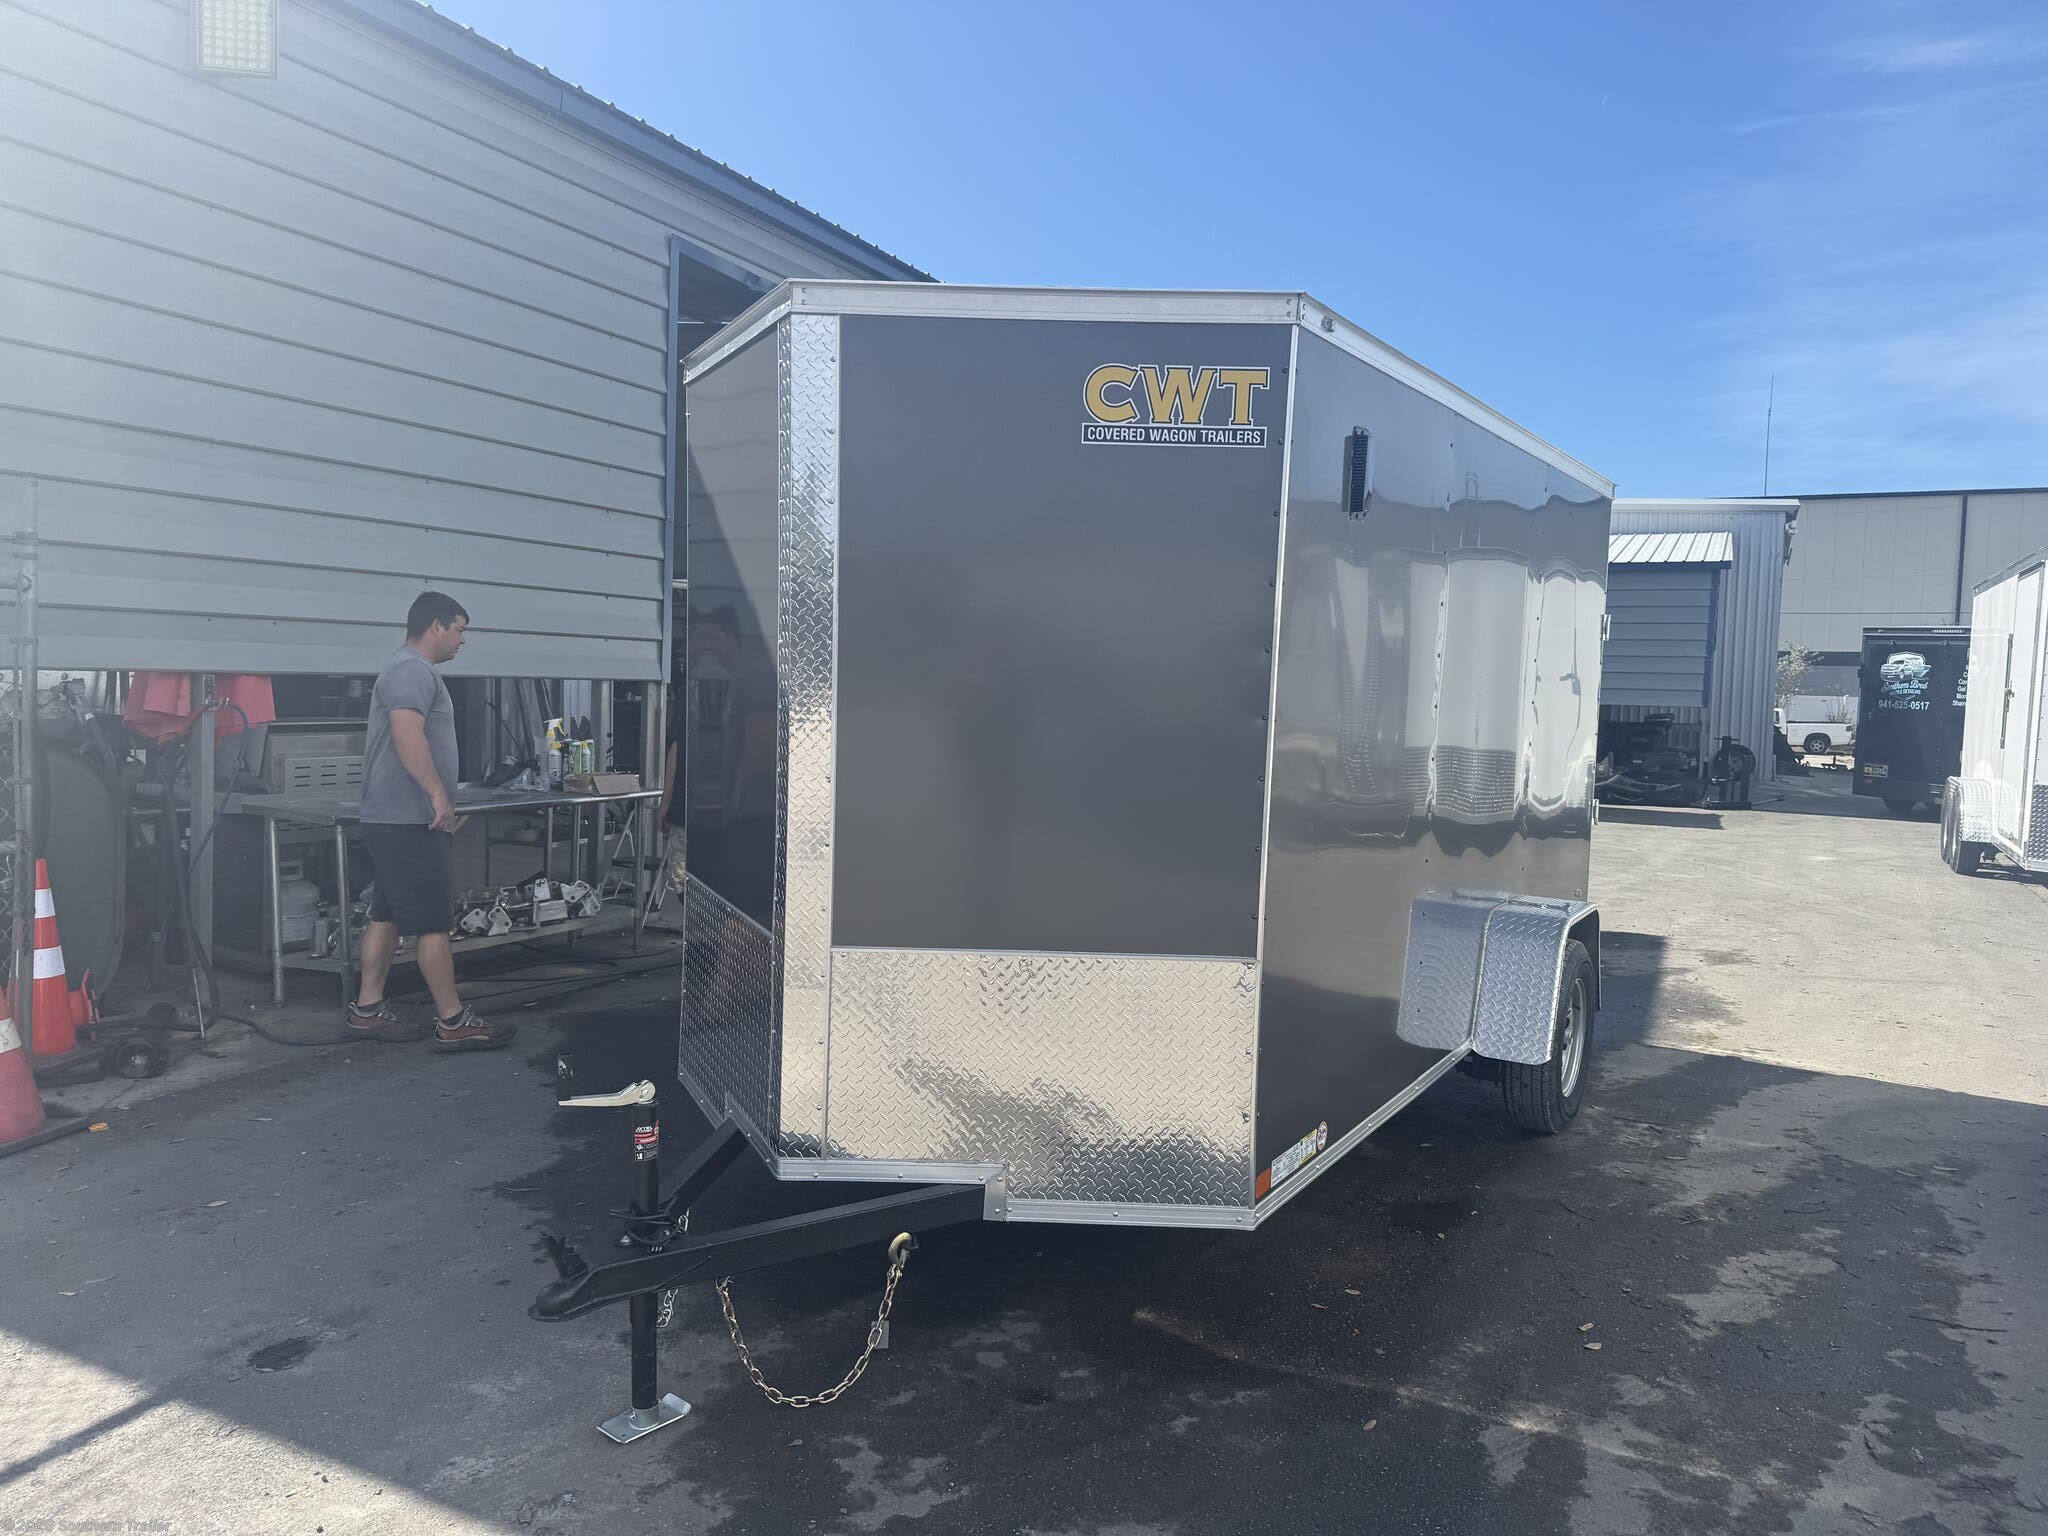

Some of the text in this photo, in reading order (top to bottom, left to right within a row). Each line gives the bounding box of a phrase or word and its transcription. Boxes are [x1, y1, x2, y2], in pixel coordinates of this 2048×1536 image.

[1083, 363, 1270, 426] CWT
[1087, 427, 1261, 444] COVERED WAGON TRAILERS
[1878, 700, 1930, 710] 941-525-0517
